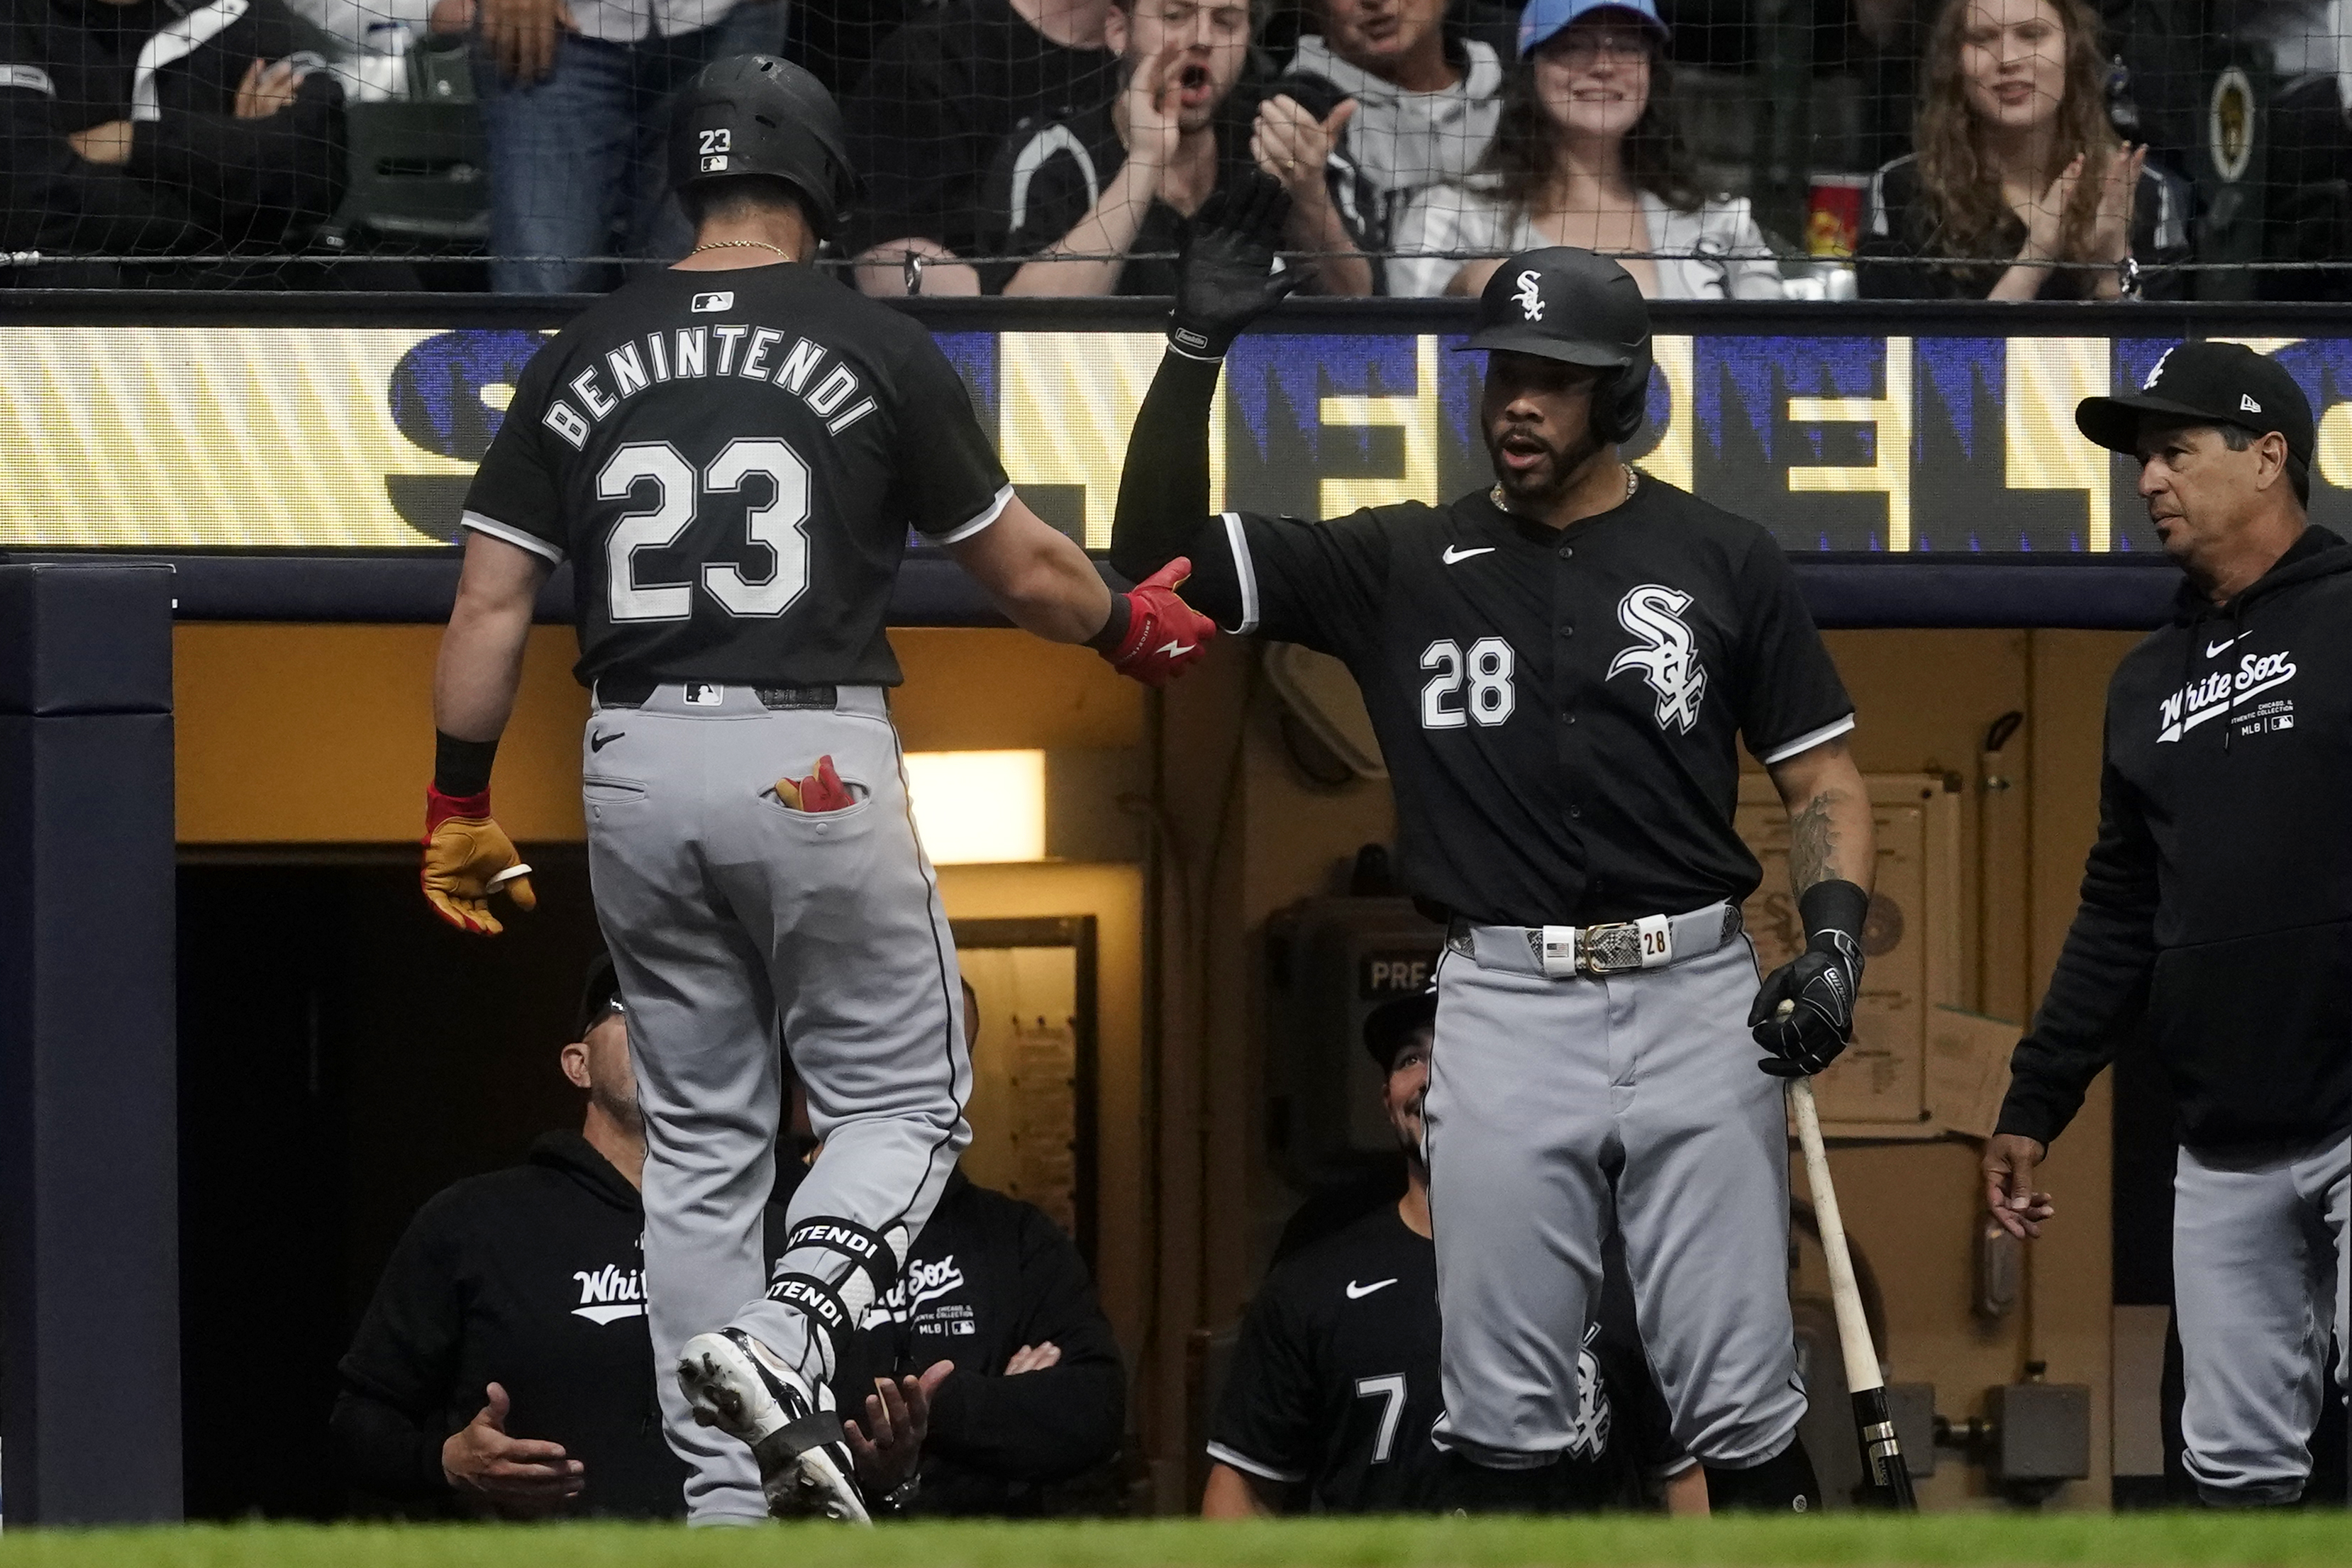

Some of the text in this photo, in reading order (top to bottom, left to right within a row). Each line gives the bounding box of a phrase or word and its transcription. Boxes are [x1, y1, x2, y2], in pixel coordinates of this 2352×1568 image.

[699, 128, 731, 155] 23
[542, 324, 877, 451] BENINTENDI
[596, 437, 811, 623] 23
[1420, 636, 1515, 729] 28
[2159, 651, 2295, 730] White Sox
[2241, 723, 2261, 736] MLB
[2258, 706, 2294, 716] COLLECTION
[1644, 930, 1665, 955] 28
[908, 1255, 962, 1296] Sox
[919, 1323, 942, 1335] MLB
[1355, 1372, 1408, 1465] 7
